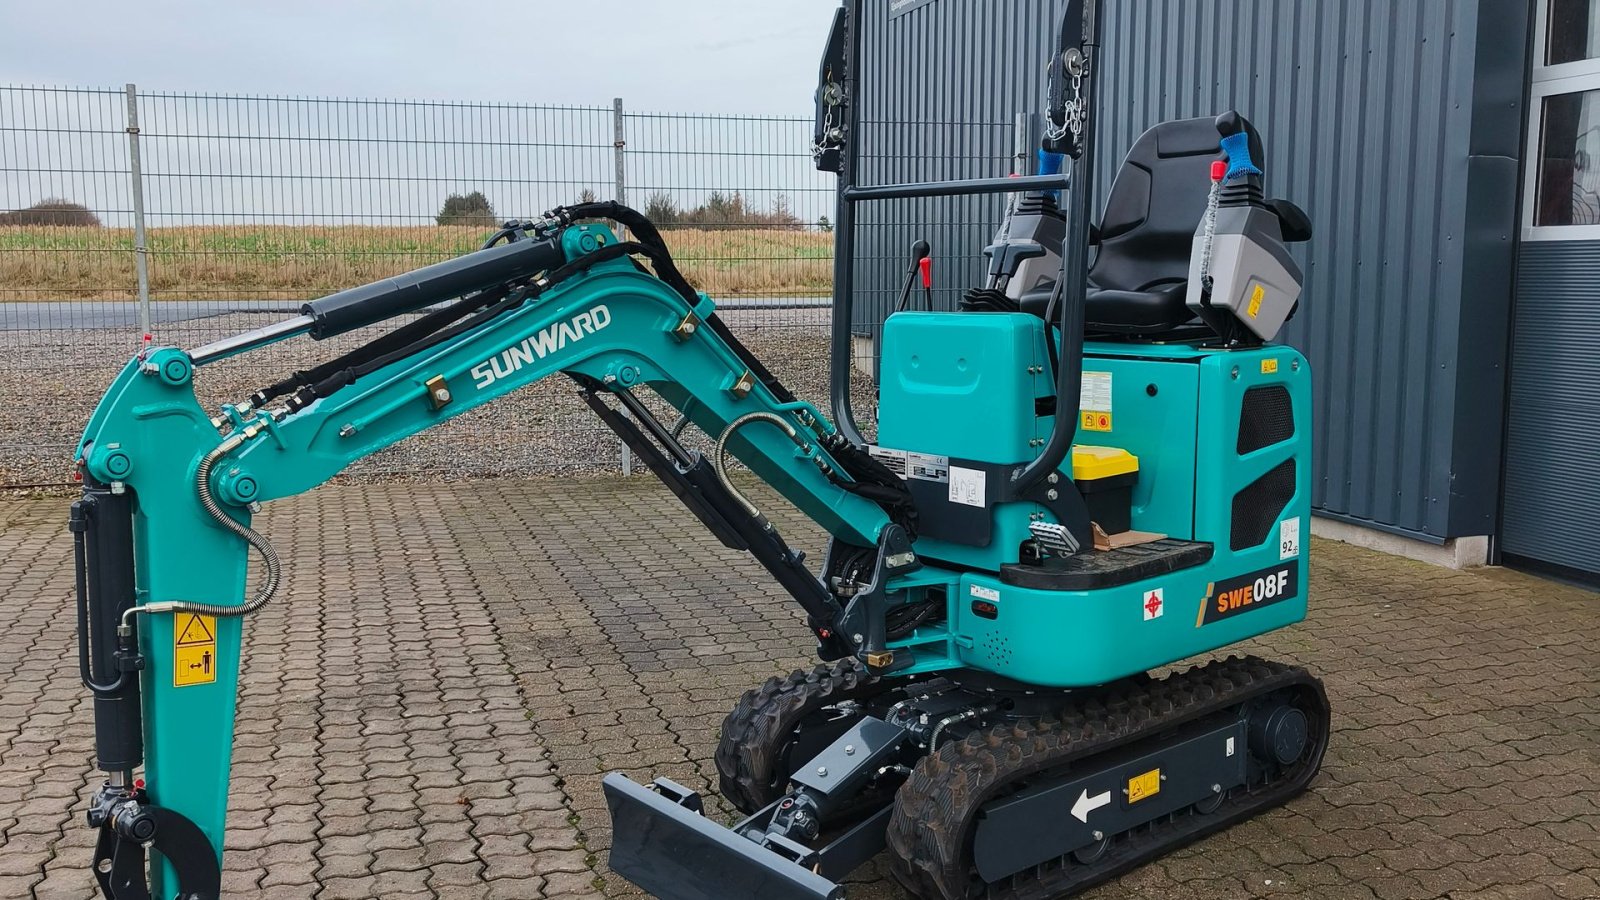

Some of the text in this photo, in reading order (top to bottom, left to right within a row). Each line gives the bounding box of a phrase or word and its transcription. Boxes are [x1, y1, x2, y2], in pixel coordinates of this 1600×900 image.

[470, 304, 611, 390] SUNWARD
[1282, 540, 1293, 553] 92
[1217, 569, 1289, 613] SWE08F
